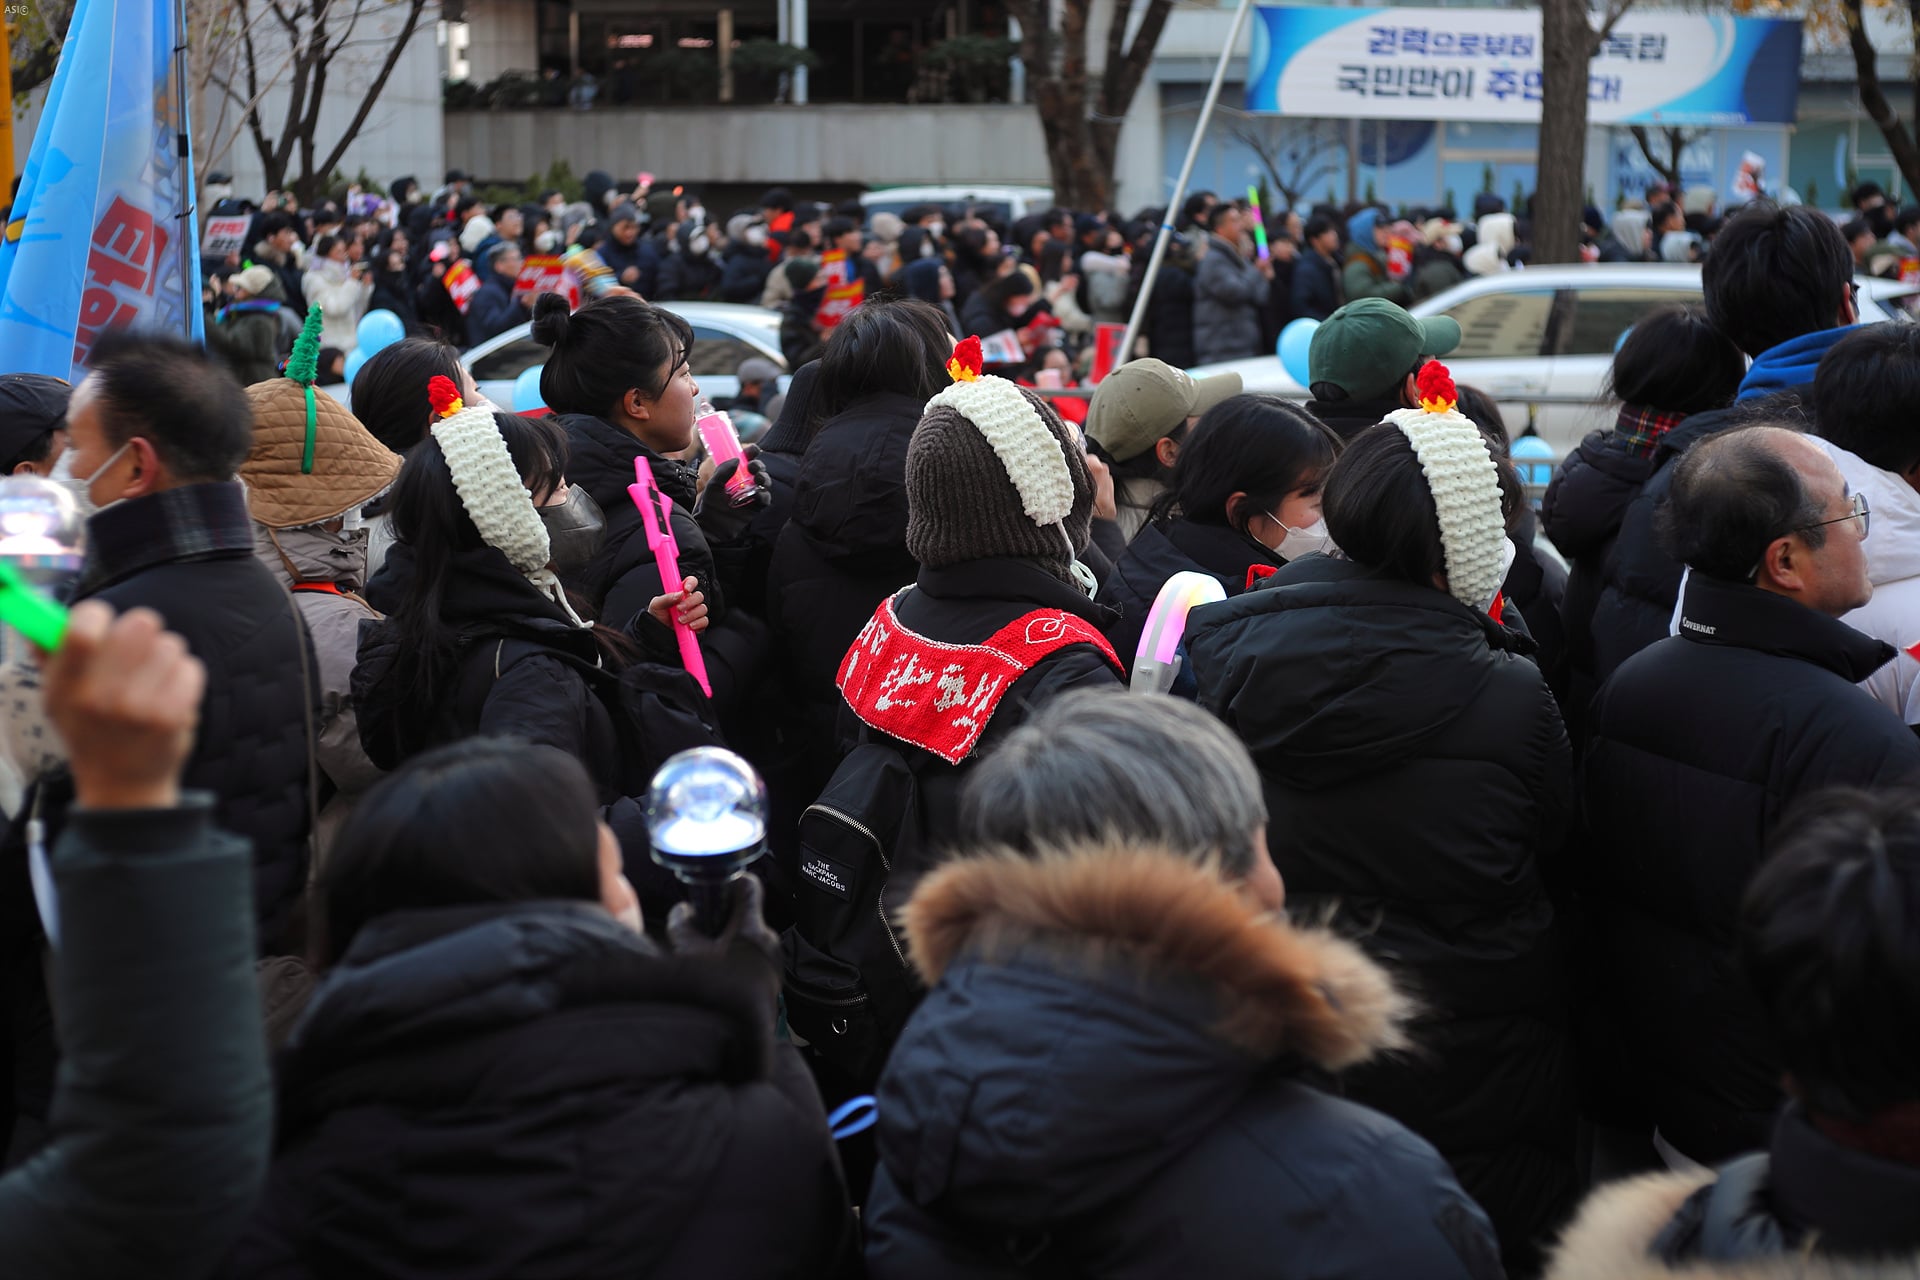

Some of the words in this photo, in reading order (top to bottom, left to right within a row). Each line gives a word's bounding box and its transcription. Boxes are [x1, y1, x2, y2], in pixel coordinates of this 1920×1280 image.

[1591, 31, 1666, 61] 독립
[1337, 64, 1475, 99] 국민만이
[1683, 616, 1716, 635] COVERNAT
[807, 862, 838, 882] BACKPACK
[817, 860, 830, 871] THE
[802, 864, 817, 879] MARC
[818, 876, 846, 892] JACOBS
